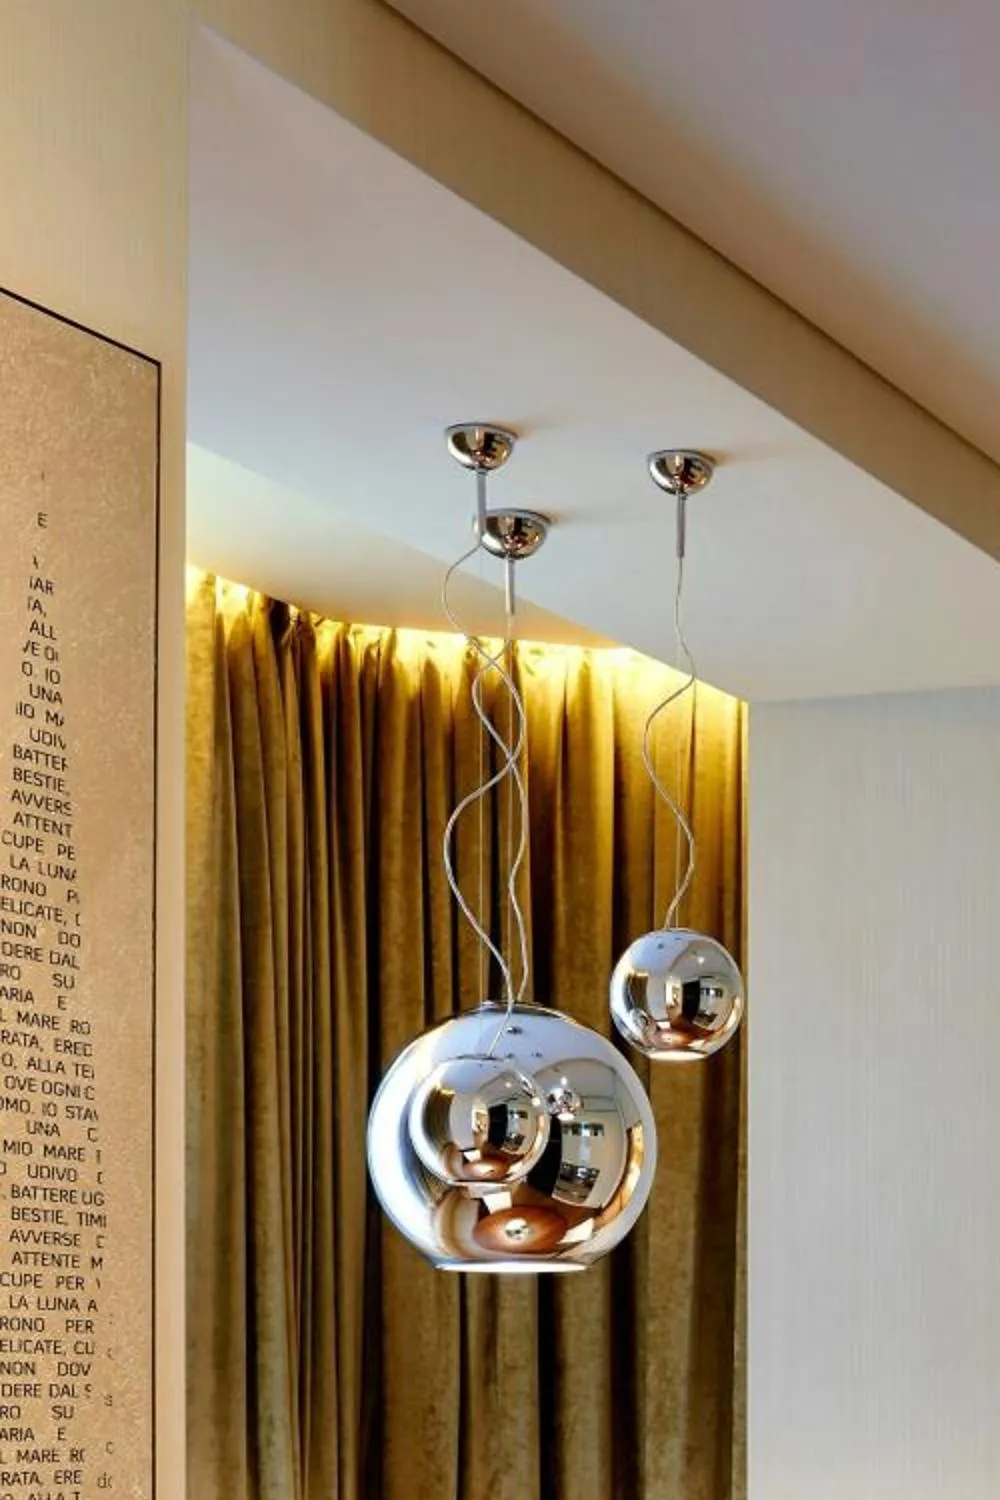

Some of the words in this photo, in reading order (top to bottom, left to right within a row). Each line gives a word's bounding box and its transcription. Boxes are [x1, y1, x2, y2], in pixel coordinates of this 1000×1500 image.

[11, 1251, 81, 1269] ATTENTE
[55, 1275, 85, 1291] PER
[9, 1294, 29, 1310] LA
[65, 1319, 95, 1335] PER
